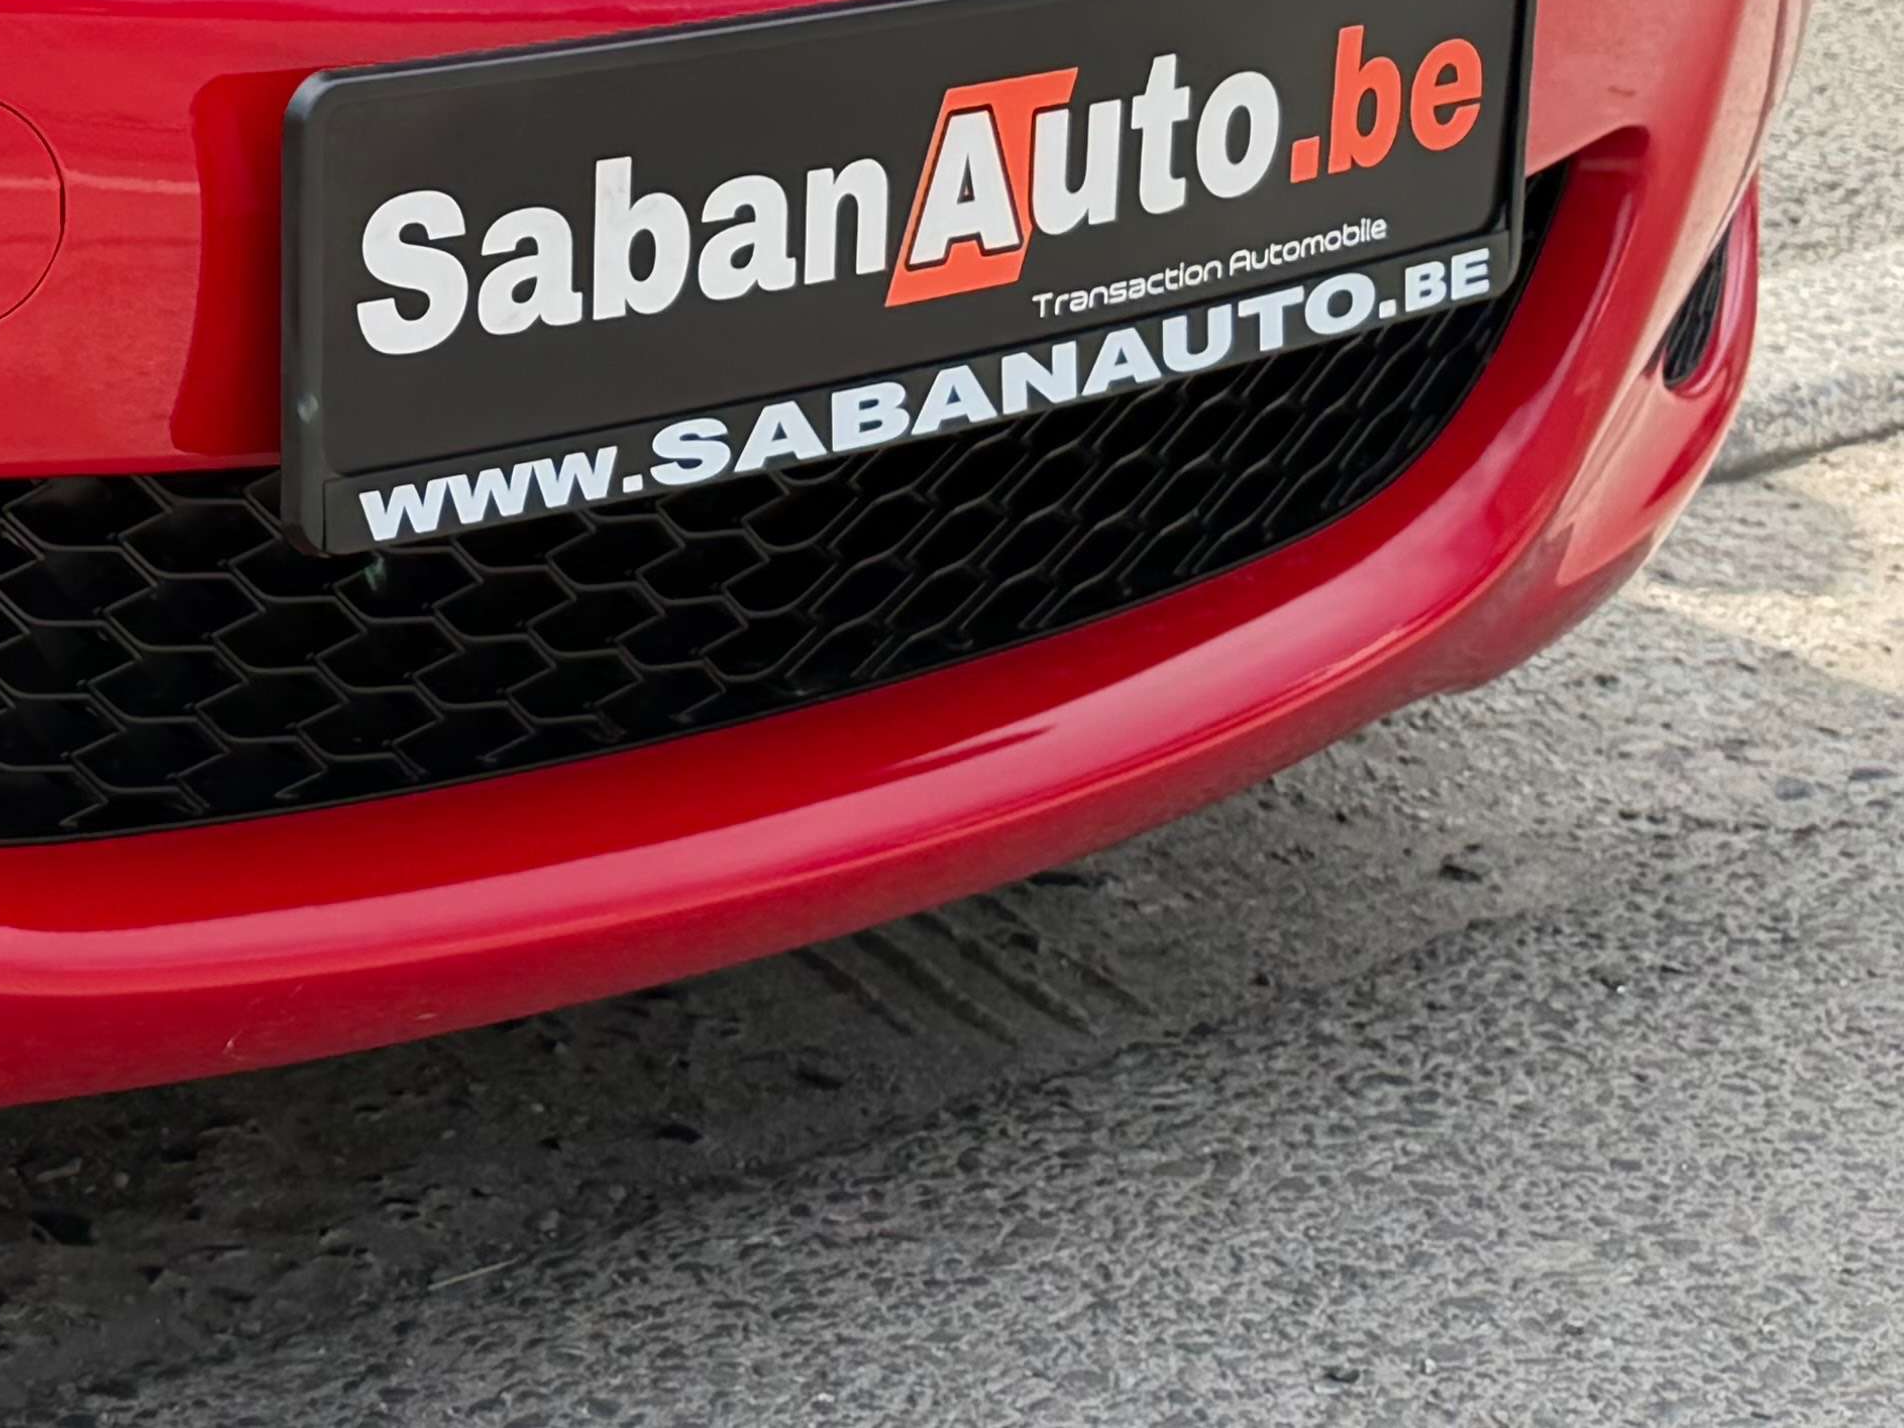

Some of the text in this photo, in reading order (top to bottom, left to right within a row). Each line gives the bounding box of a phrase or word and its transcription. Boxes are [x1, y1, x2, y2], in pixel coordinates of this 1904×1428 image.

[355, 24, 1485, 356] SabanAuto.be
[1031, 216, 1388, 319] Transaction Automobile
[358, 247, 1494, 542] www.SABANAUTO.BE
